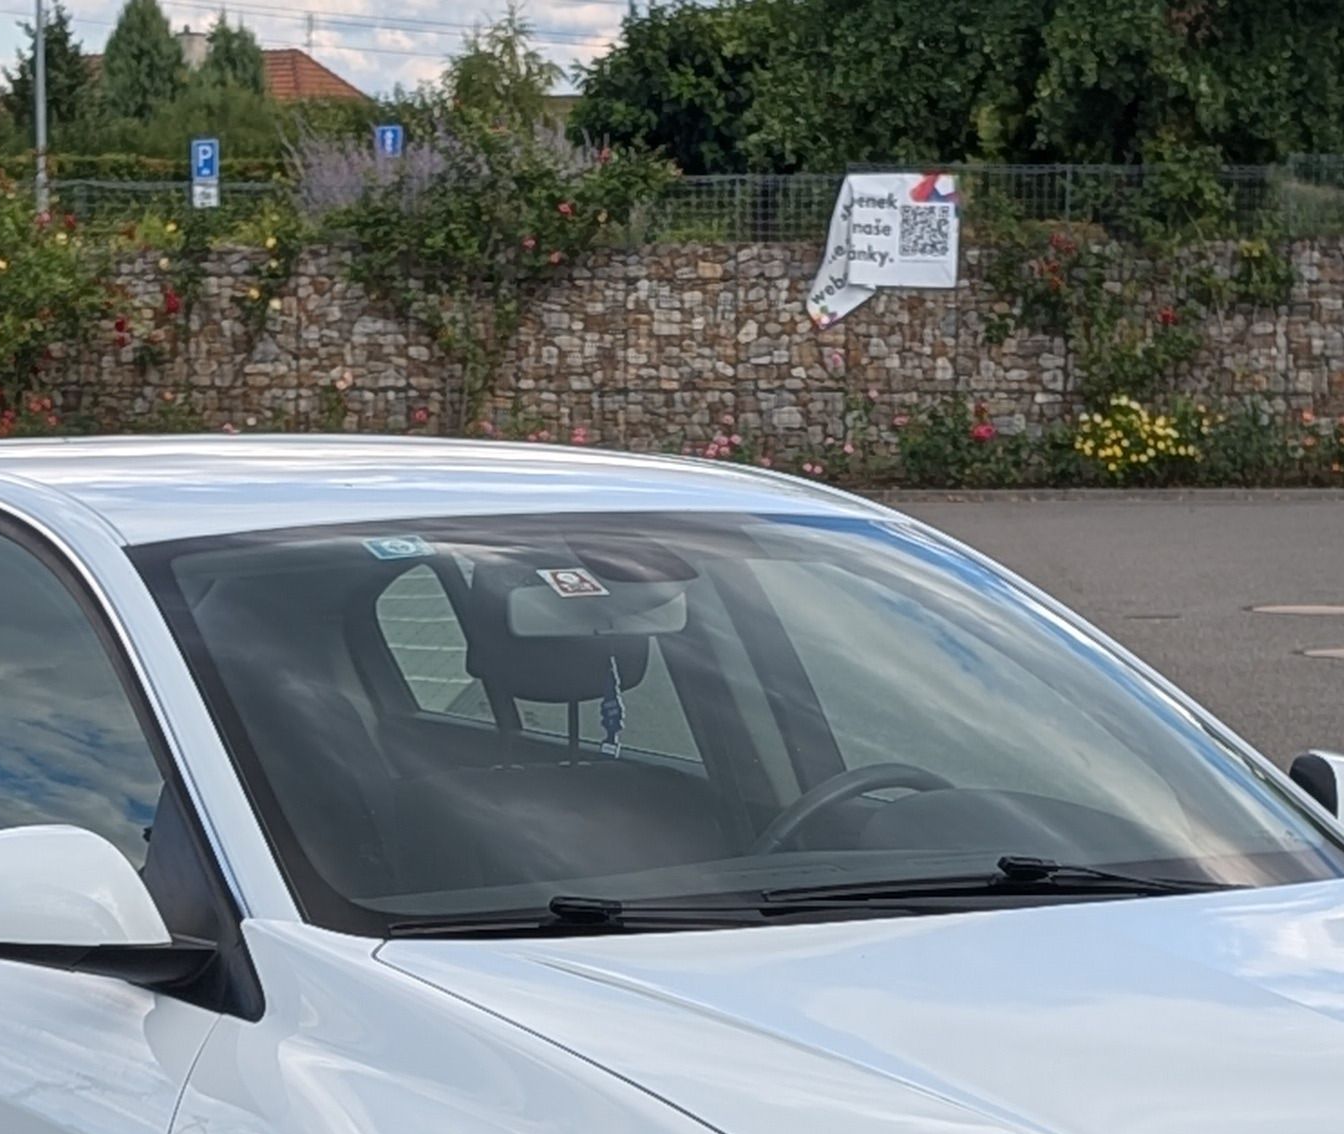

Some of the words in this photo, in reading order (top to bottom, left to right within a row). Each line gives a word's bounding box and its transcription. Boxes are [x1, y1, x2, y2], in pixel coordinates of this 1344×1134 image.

[198, 144, 213, 168] P
[855, 193, 898, 210] enek
[852, 218, 892, 236] naše
[848, 244, 894, 267] ánky.
